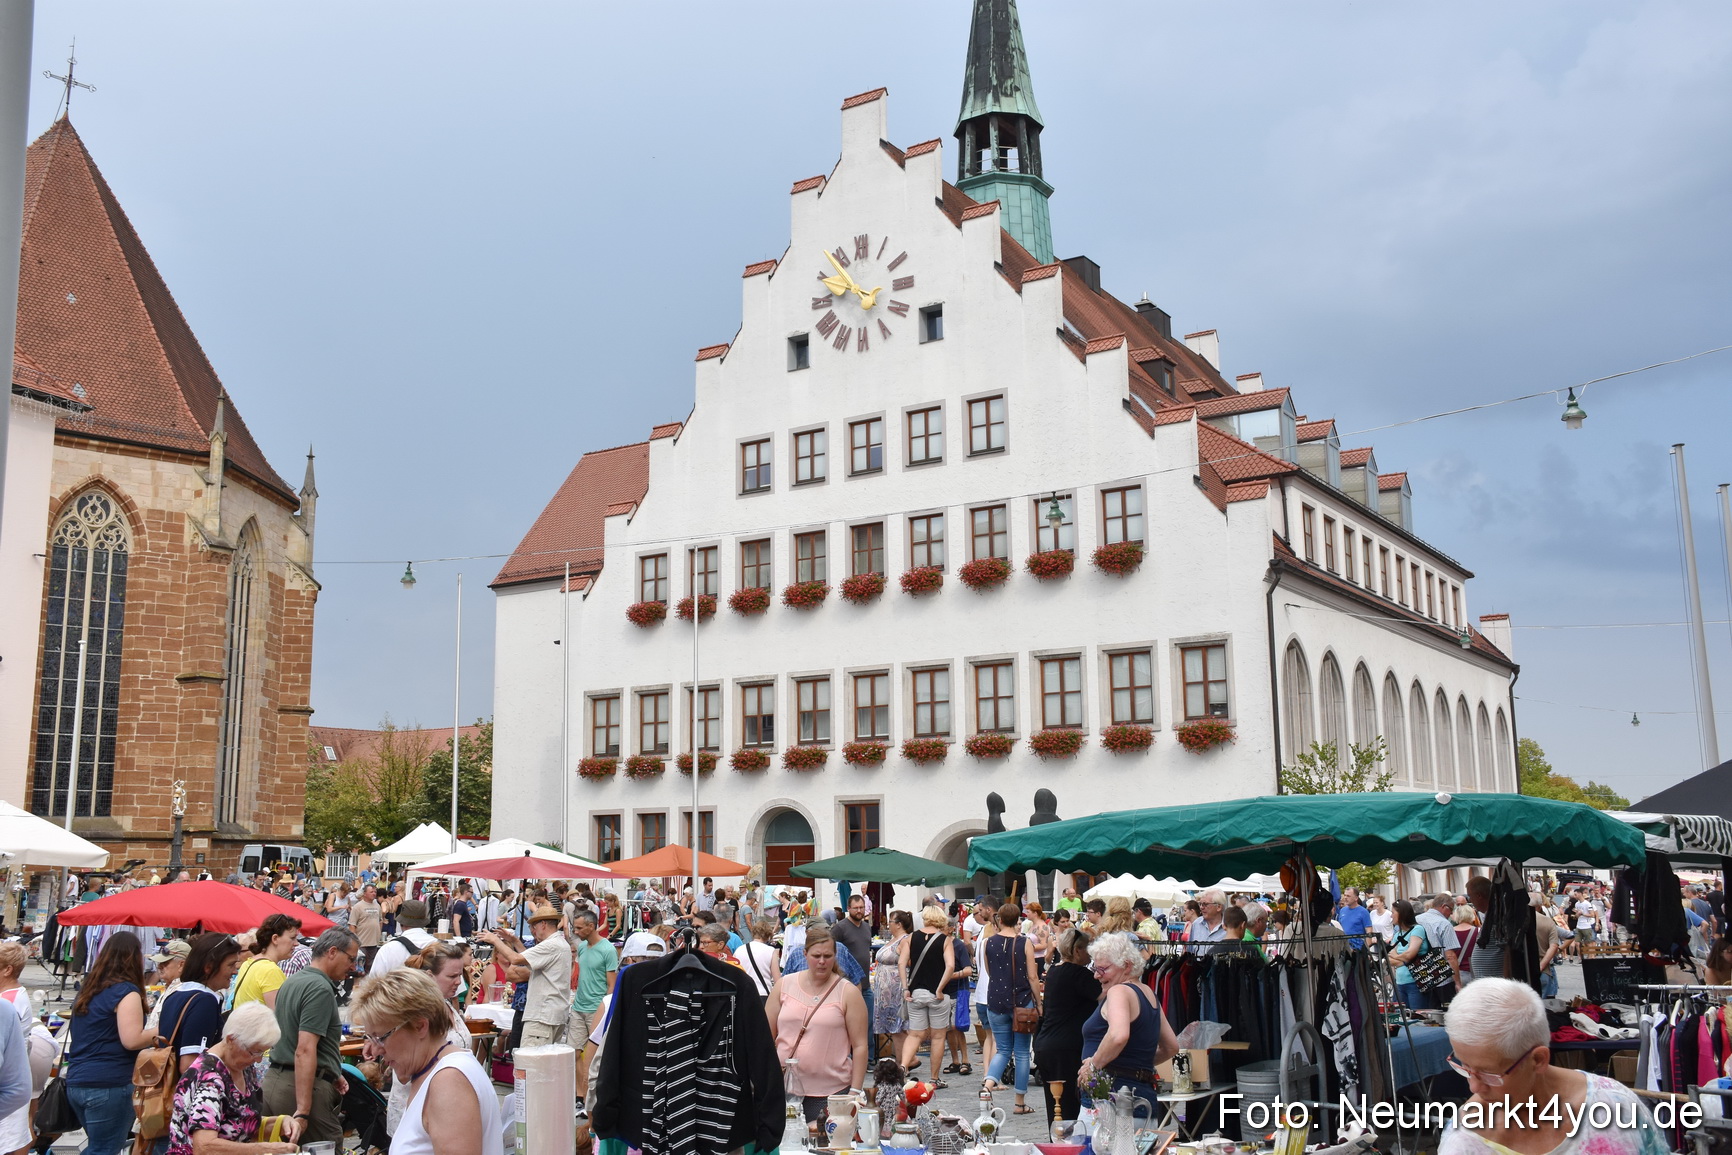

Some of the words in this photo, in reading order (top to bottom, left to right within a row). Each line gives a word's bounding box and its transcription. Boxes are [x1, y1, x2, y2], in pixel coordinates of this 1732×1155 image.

[853, 233, 869, 261] XII
[876, 235, 888, 260] I
[886, 250, 908, 272] II
[892, 274, 915, 291] III
[815, 309, 840, 340] VIII
[877, 318, 892, 340] V
[832, 323, 852, 352] VII
[857, 326, 869, 352] VI
